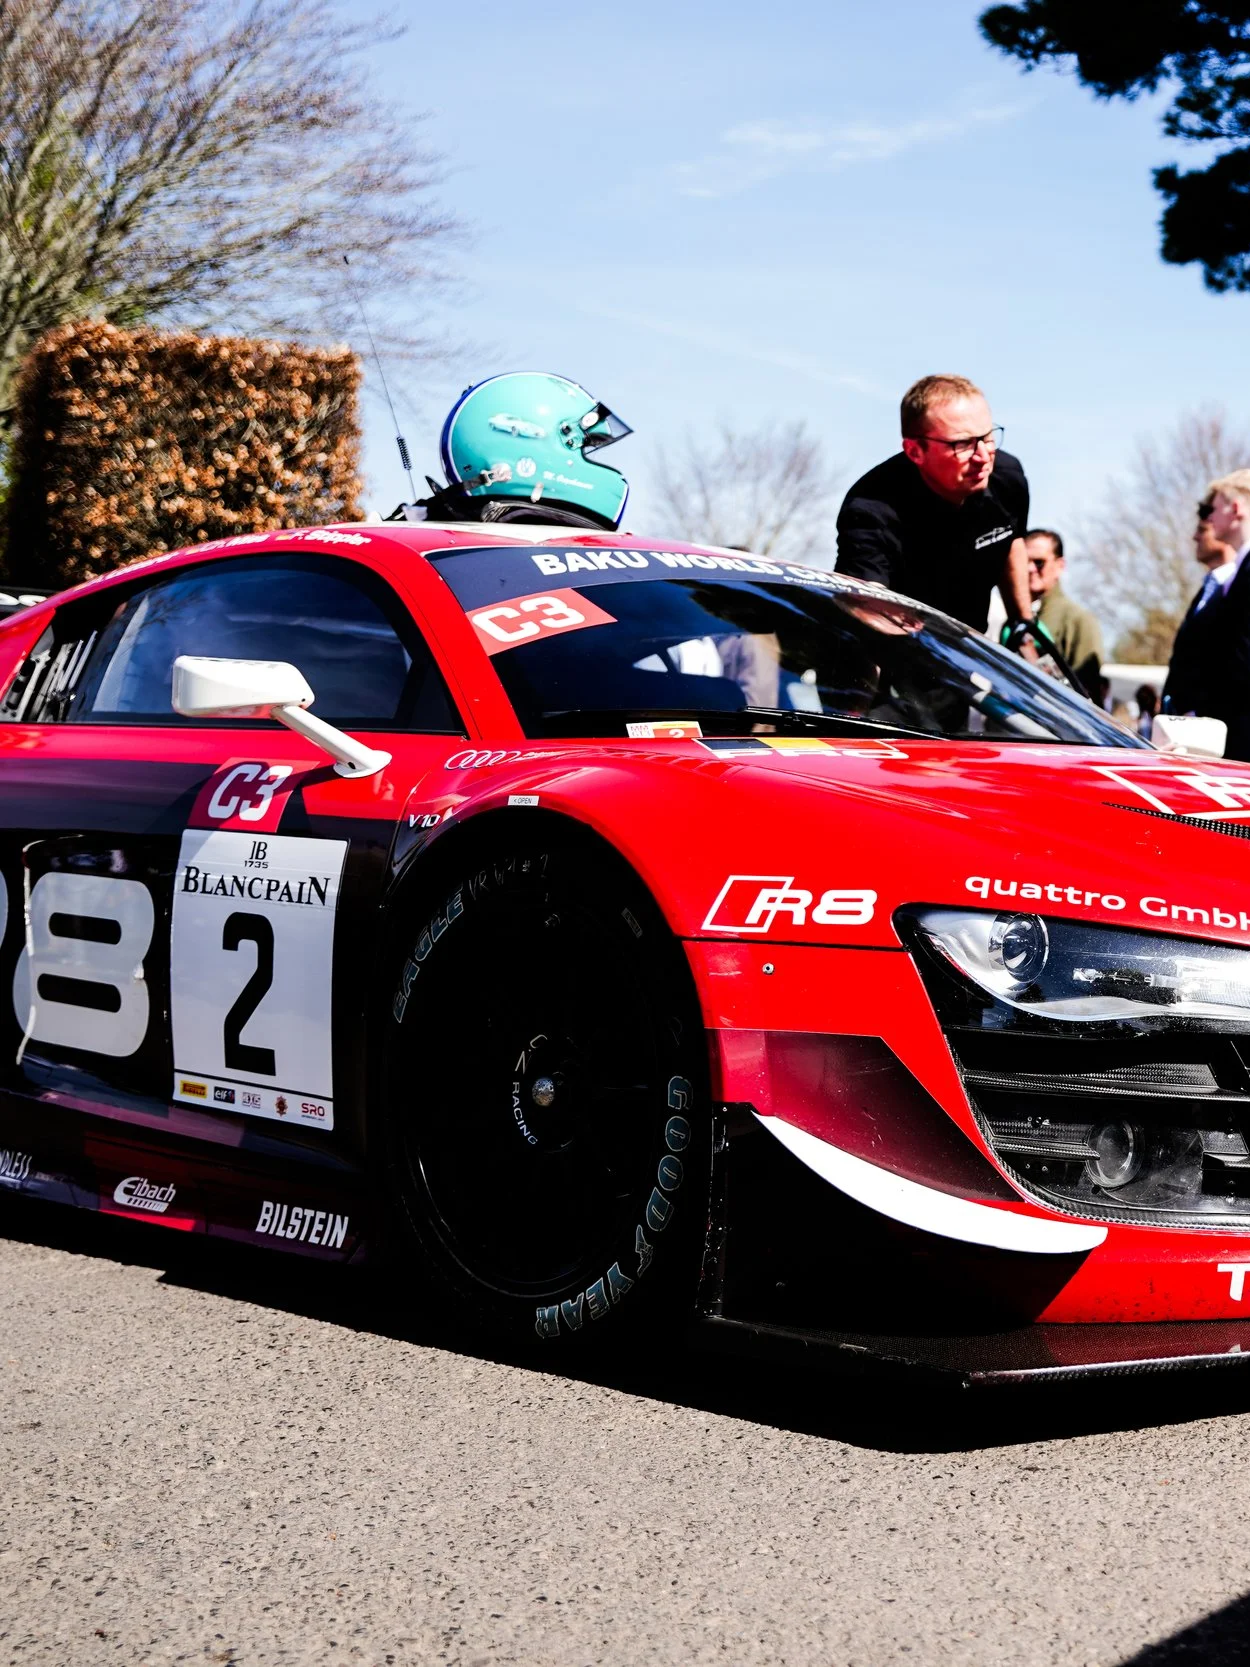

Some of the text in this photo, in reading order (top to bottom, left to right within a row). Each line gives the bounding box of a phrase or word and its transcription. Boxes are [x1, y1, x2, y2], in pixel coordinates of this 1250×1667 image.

[531, 551, 784, 576] BAKU WORLD
[471, 595, 586, 643] C3
[208, 763, 293, 822] C3
[410, 813, 441, 828] V10
[244, 860, 269, 869] 1735
[181, 866, 332, 906] BLANCPAIN
[965, 875, 1127, 911] quattro
[745, 888, 878, 926] R8
[392, 881, 464, 1025] EAGLE
[222, 912, 276, 1076] 2
[214, 1089, 228, 1100] elf
[301, 1102, 326, 1117] SRO
[512, 1081, 538, 1145] RACING
[113, 1176, 177, 1204] Eibach
[255, 1200, 349, 1249] BILSTEIN
